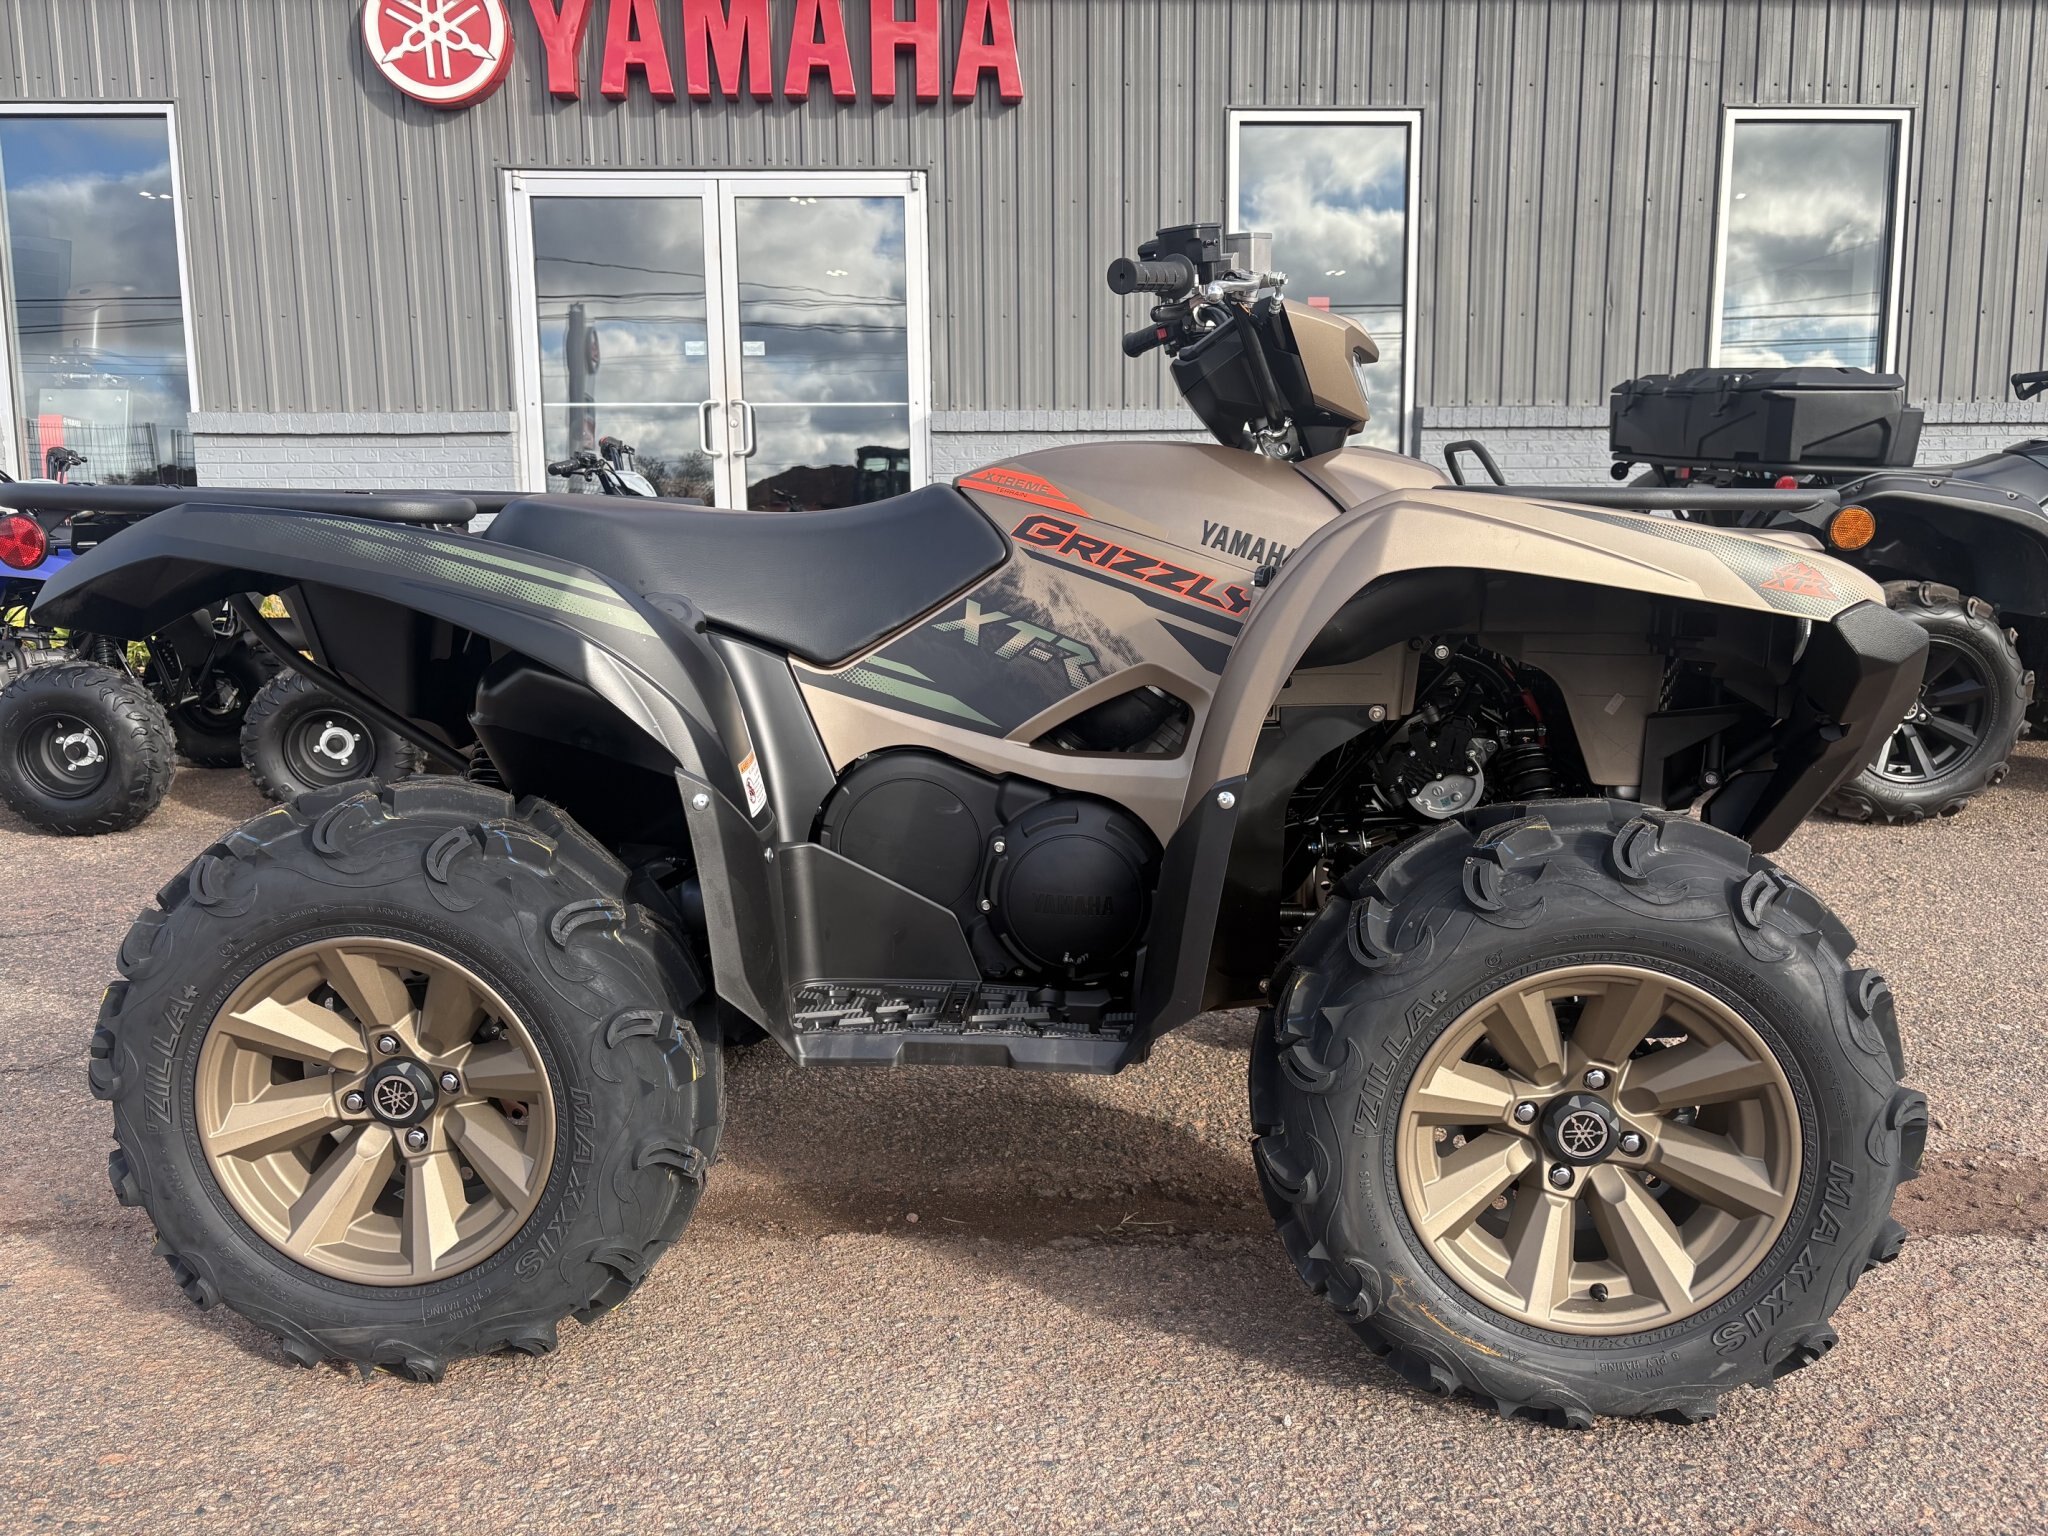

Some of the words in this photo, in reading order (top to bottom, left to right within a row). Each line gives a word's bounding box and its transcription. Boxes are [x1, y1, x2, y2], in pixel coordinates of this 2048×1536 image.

[527, 0, 1023, 104] YAMAHA
[984, 471, 1050, 494] XTREME
[995, 486, 1028, 498] TERRAIN
[1011, 514, 1251, 616] GRIZZLY
[1032, 892, 1114, 916] YAMAHA
[514, 1086, 596, 1284] MAXXIS
[1711, 1160, 1857, 1357] MAXXIS
